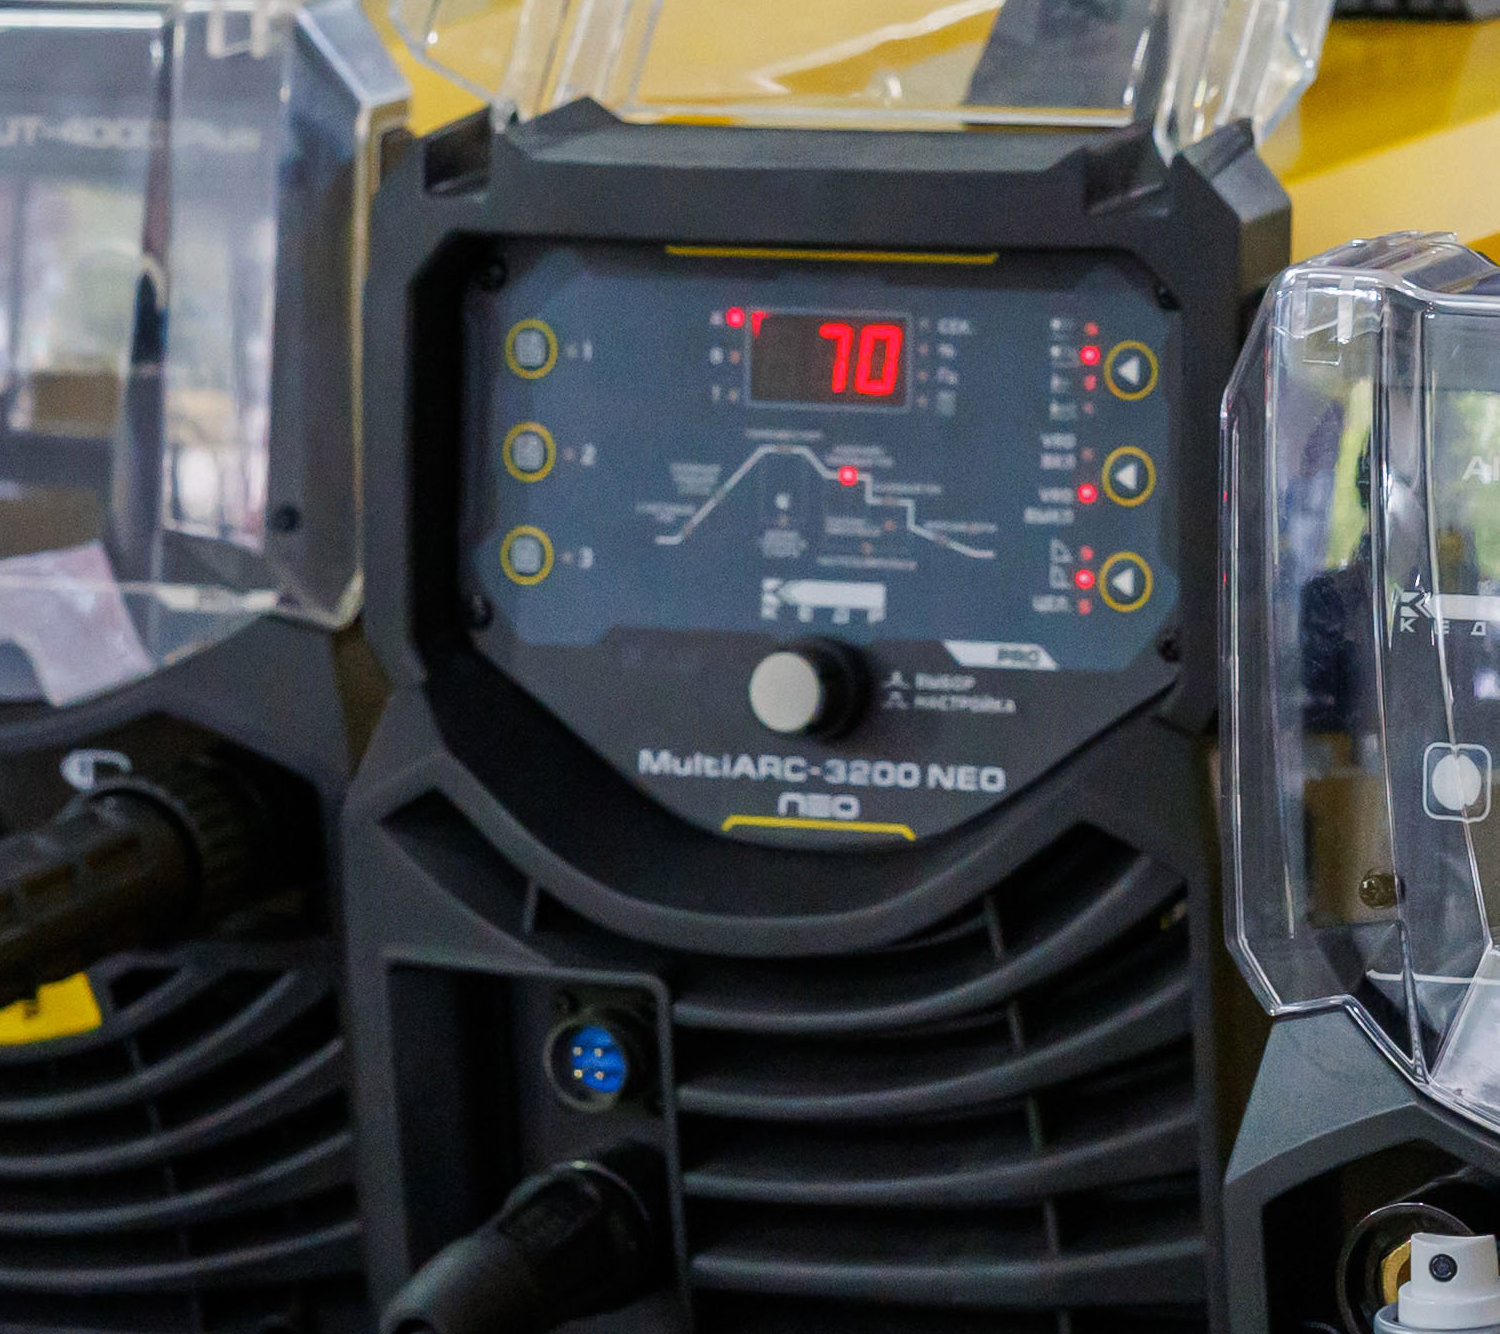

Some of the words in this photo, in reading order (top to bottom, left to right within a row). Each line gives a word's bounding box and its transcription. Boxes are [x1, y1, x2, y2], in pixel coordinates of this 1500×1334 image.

[819, 323, 902, 395] 70
[638, 748, 922, 790] MultiARC-3200
[926, 763, 1007, 794] NEO
